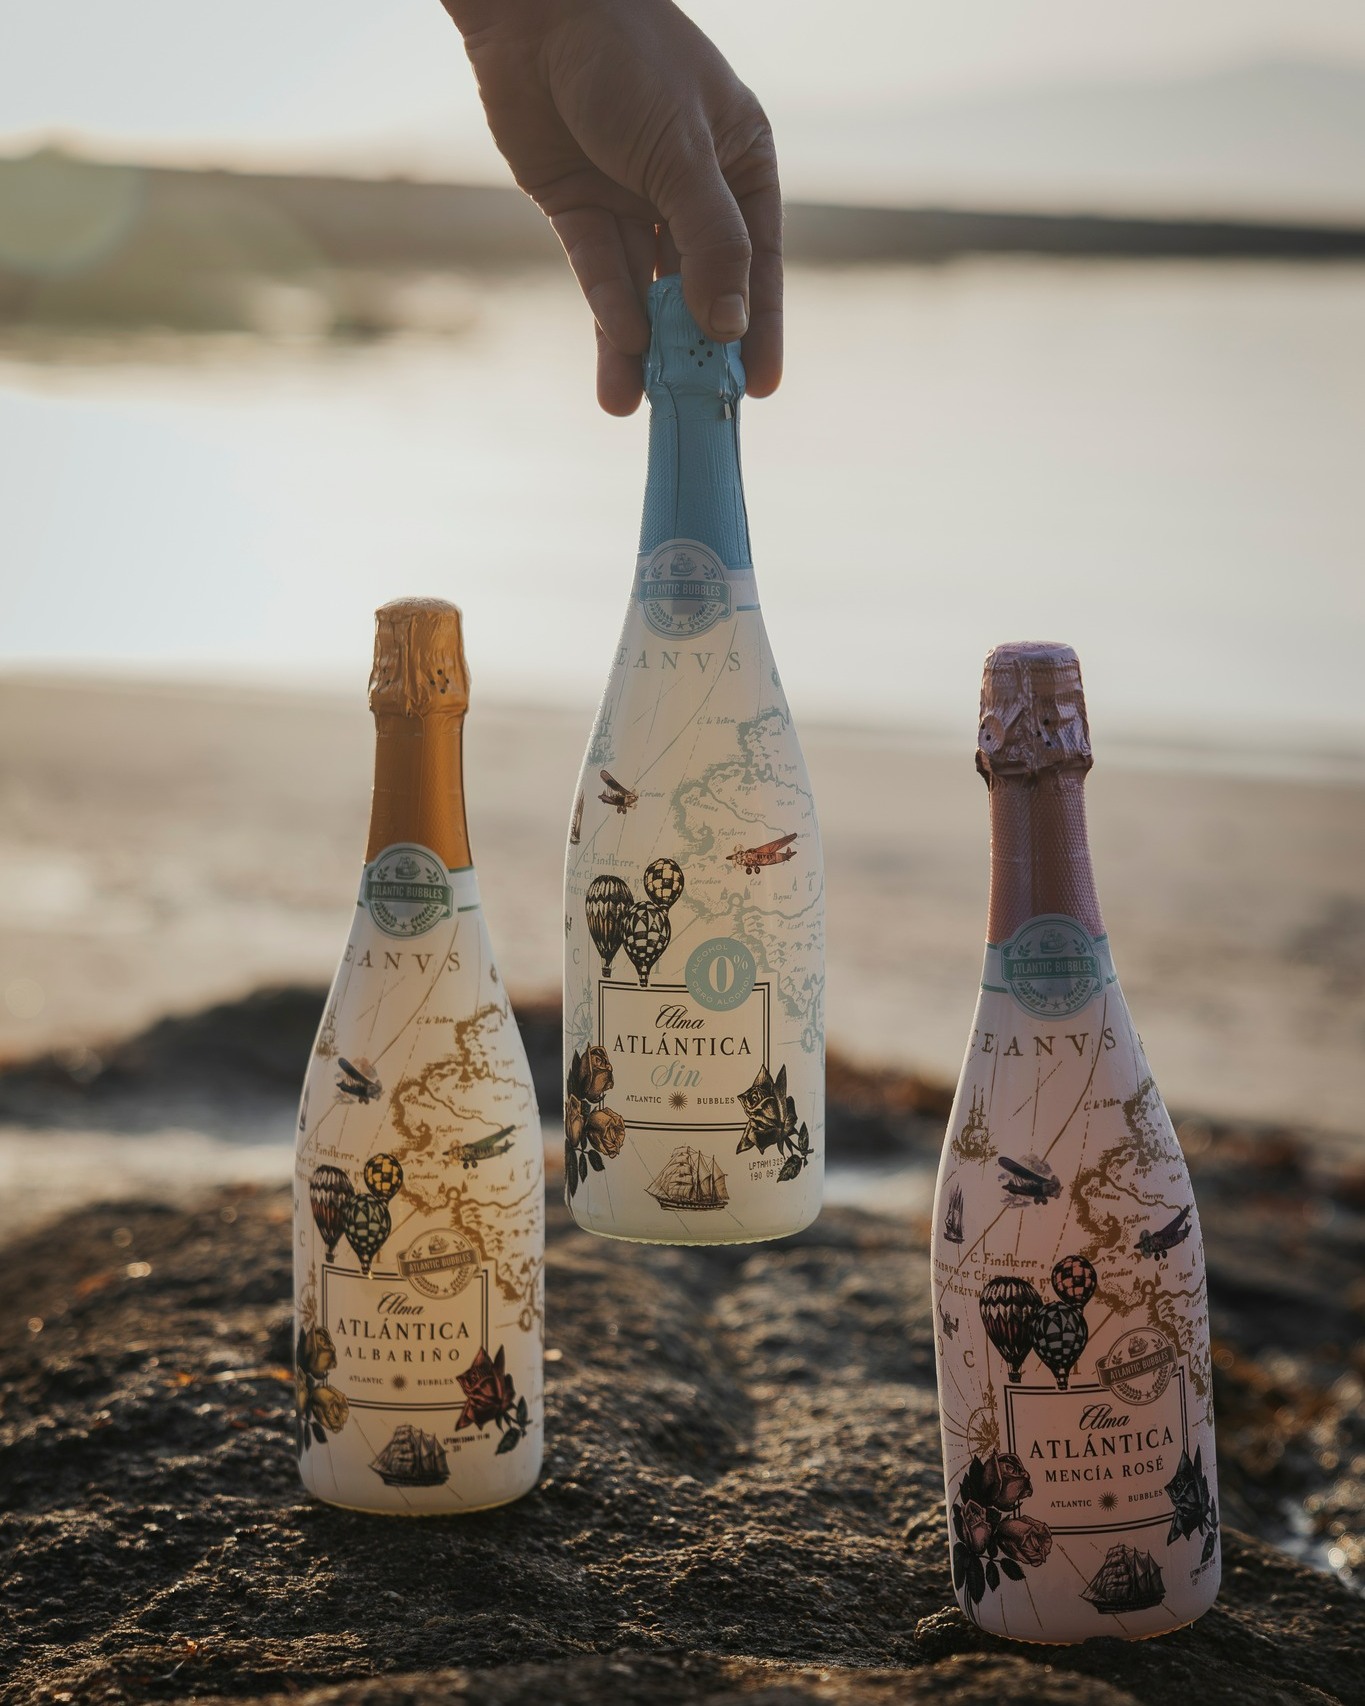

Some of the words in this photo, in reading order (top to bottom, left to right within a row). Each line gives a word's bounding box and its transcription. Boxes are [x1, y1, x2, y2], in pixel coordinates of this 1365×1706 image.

[646, 583, 680, 596] ATLANTIC
[682, 583, 721, 597] BUBBLES
[371, 884, 405, 897] ATLANTIC
[406, 886, 443, 900] BUBBLES
[692, 944, 728, 975] ALCOHOL
[1012, 959, 1052, 975] ATLANTIC
[1054, 959, 1092, 974] BUBBLES
[717, 974, 751, 1005] ALCOHOL
[655, 1004, 705, 1029] Alma
[613, 1032, 751, 1057] ATLÁNTICA
[650, 1060, 703, 1088] Sin
[626, 1095, 662, 1105] ATLANTIC
[697, 1097, 735, 1105] BUBBLES
[409, 1259, 439, 1273] ATLANTIC
[441, 1253, 472, 1267] BUBBLES
[377, 1292, 425, 1316] Alma
[336, 1317, 470, 1341] ATLÁNTICA
[345, 1347, 461, 1363] ALBARIÑO
[1110, 1362, 1143, 1381] ATLANTIC
[1143, 1351, 1169, 1368] BUBBLES
[349, 1375, 384, 1385] ATLANTIC
[417, 1378, 455, 1387] BUBBLES
[1079, 1404, 1130, 1431] Alma
[1029, 1426, 1174, 1459] ATLÁNTICA
[1045, 1464, 1114, 1483] MENCÍA
[1122, 1455, 1164, 1478] ROSÉ
[1050, 1499, 1092, 1509] ATLANTIC
[1128, 1489, 1164, 1503] BUBBLES
